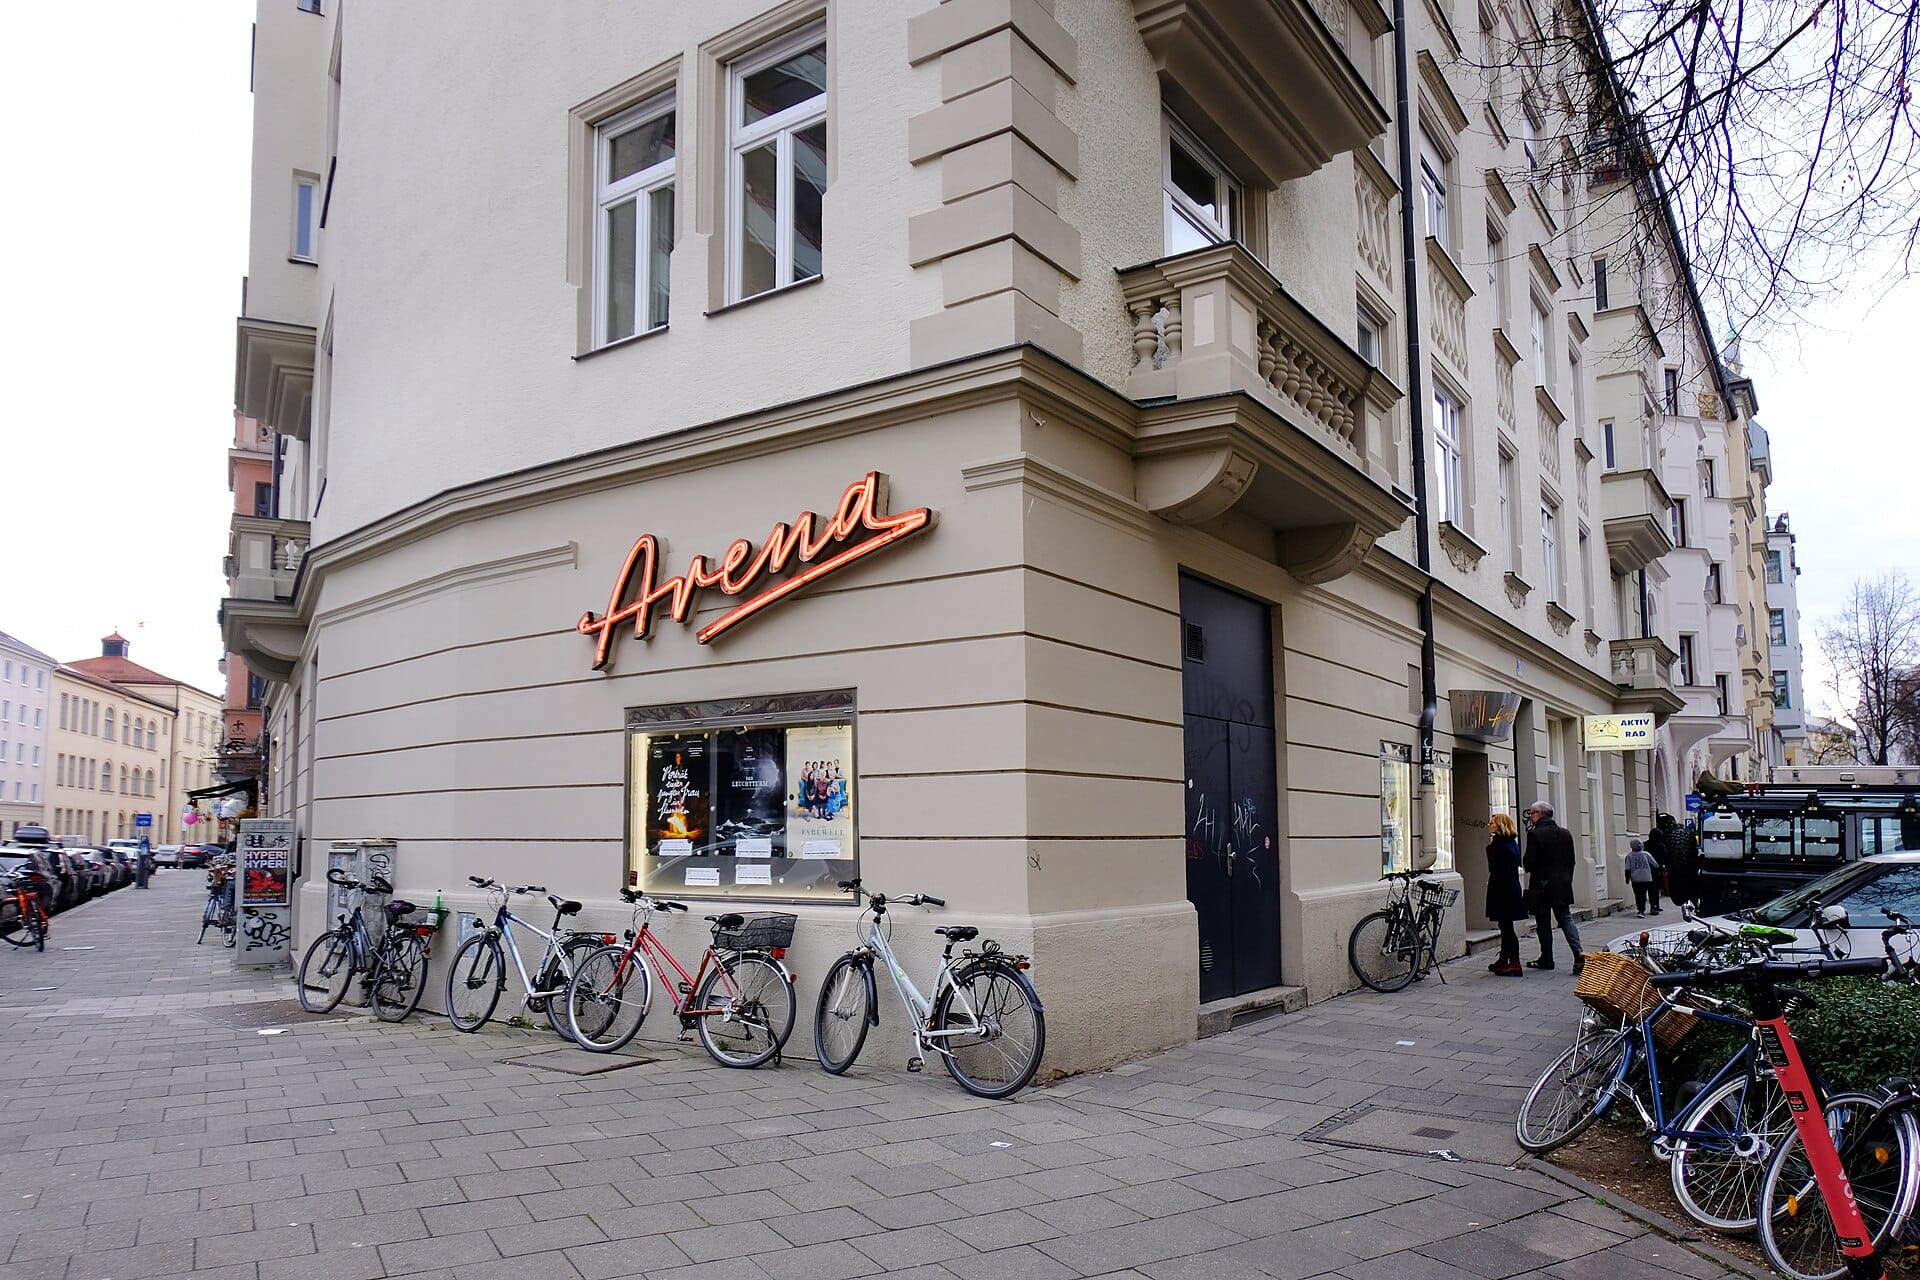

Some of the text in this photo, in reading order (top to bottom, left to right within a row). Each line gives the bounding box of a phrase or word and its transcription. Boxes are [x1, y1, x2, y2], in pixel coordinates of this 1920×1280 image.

[576, 471, 932, 671] Arena
[1620, 718, 1650, 727] AKTIV
[1625, 730, 1647, 738] RAD
[1686, 819, 1692, 827] P
[244, 851, 287, 860] HYPER!
[244, 860, 287, 869] HYPER!
